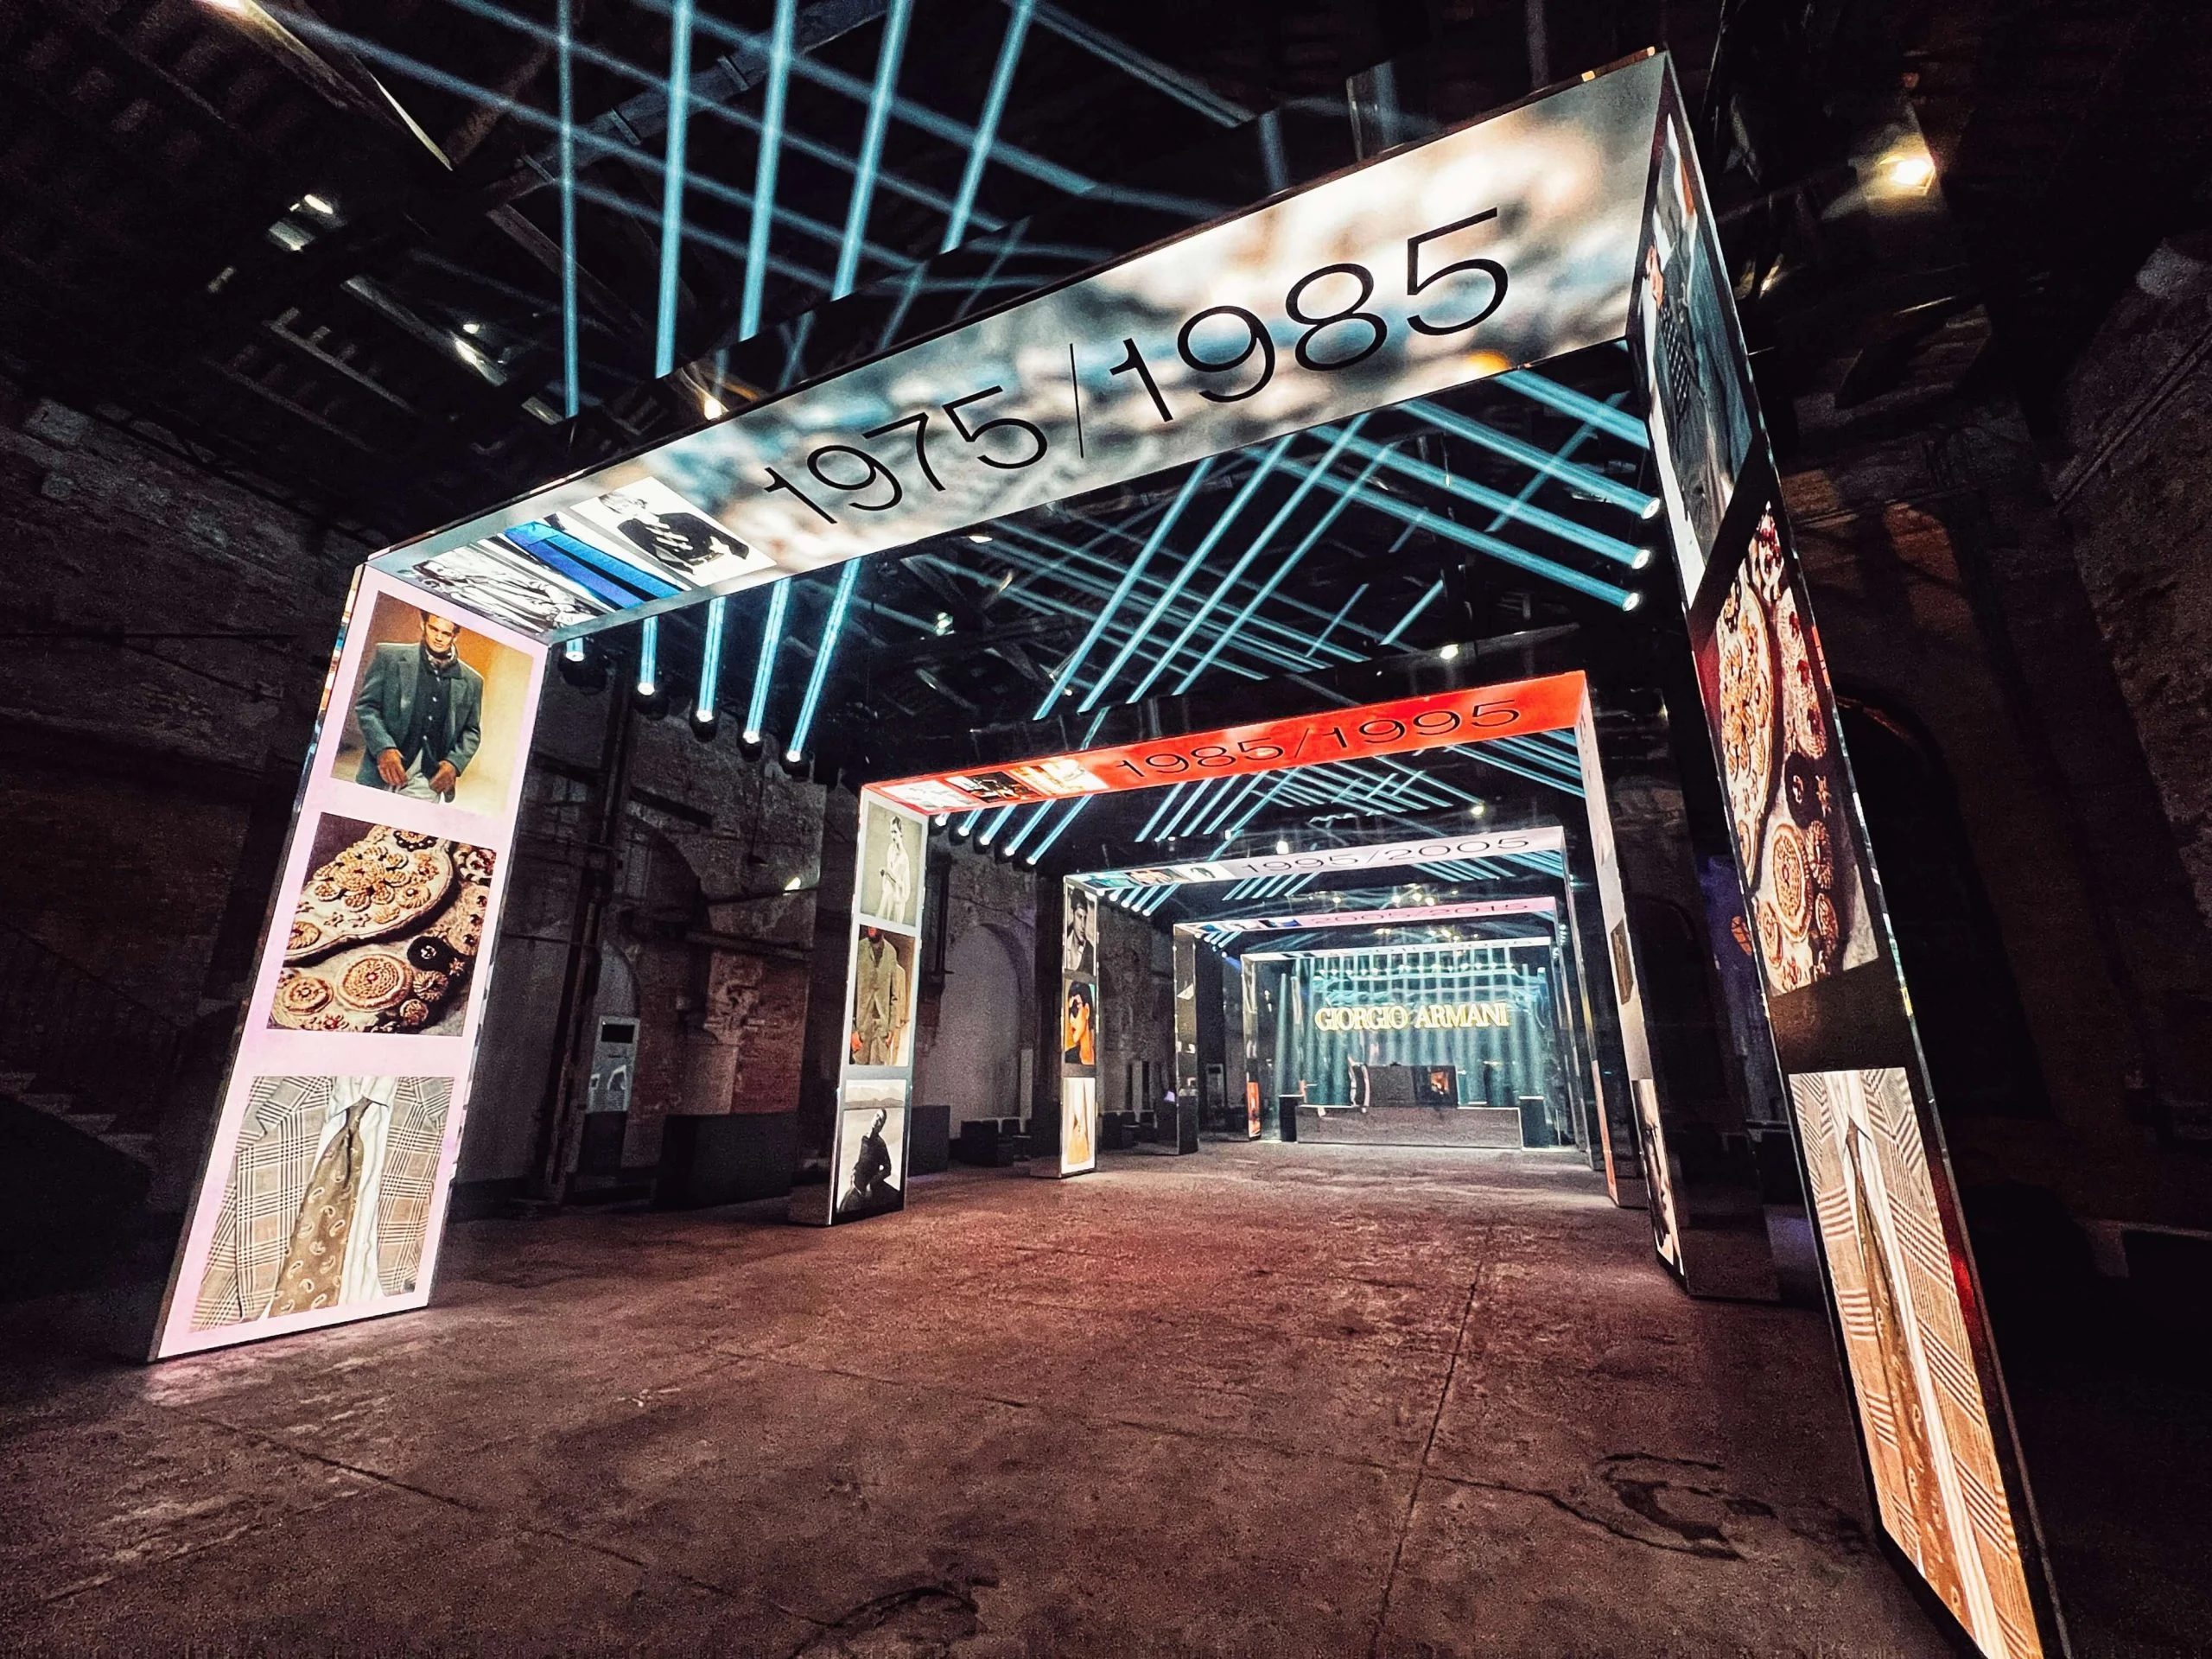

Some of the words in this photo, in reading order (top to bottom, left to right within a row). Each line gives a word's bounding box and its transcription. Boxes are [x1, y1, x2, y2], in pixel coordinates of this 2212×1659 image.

[1116, 699, 1520, 778] 1985/1995
[1242, 836, 1529, 873] 1995/2005
[1314, 1005, 1408, 1031] GIORGIO
[1414, 1001, 1510, 1028] ARMANI
